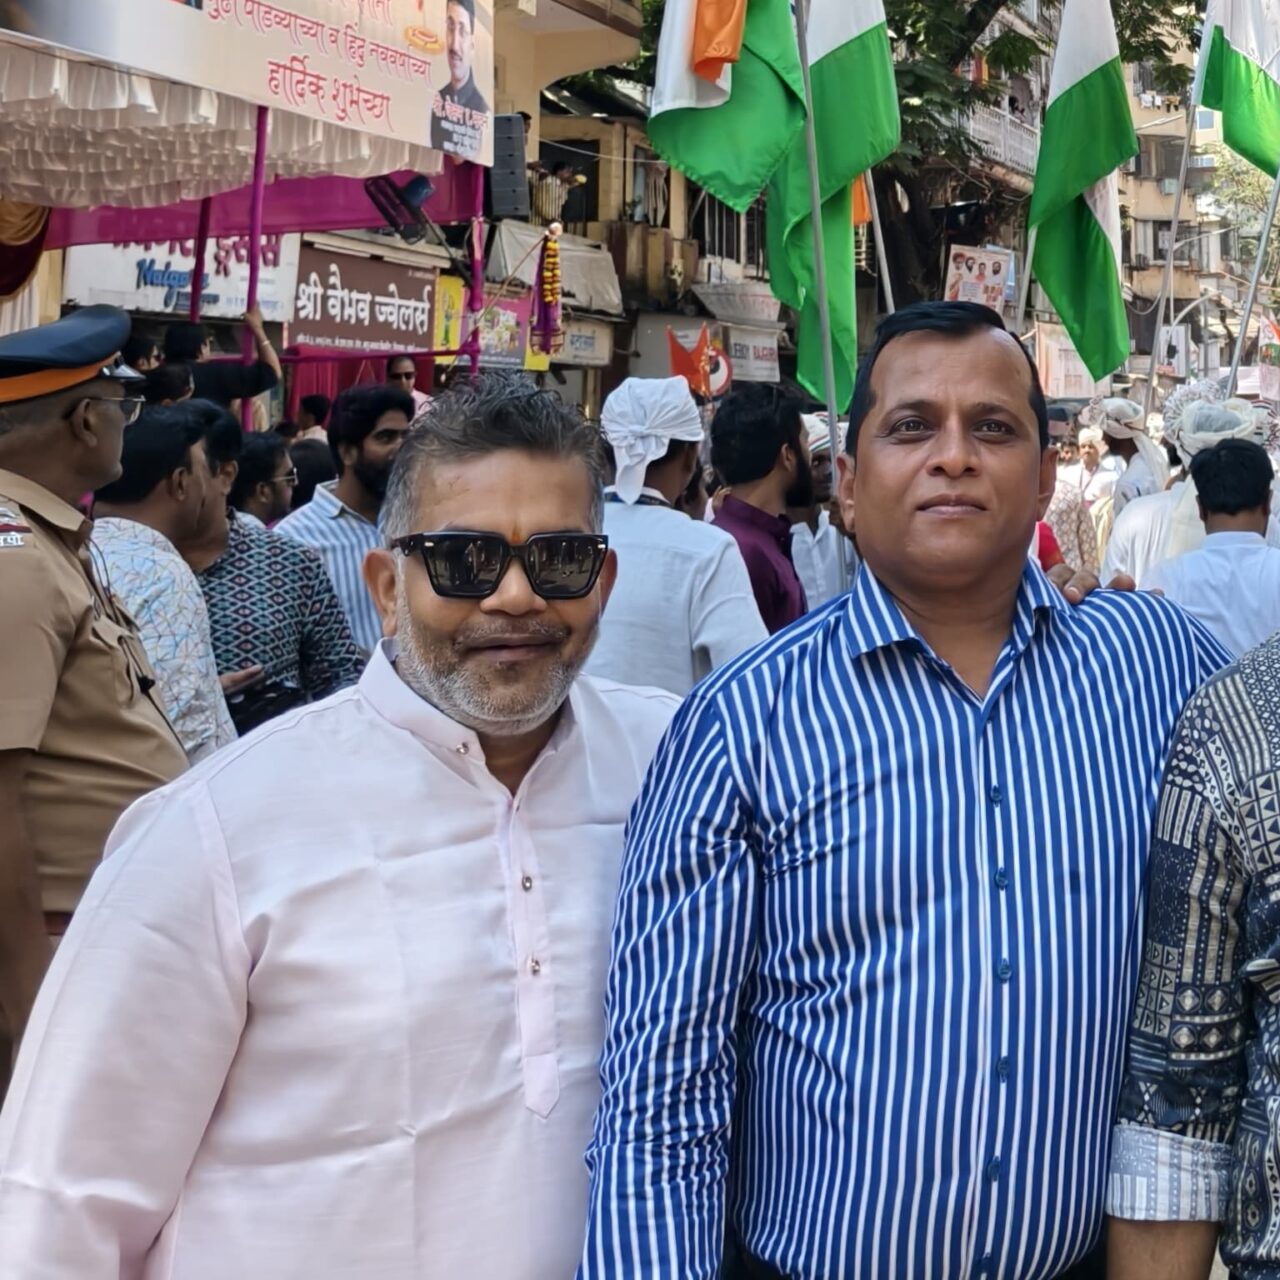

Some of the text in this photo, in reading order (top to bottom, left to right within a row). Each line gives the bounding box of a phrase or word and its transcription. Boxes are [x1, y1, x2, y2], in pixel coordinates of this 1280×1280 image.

[328, 26, 342, 56] व
[267, 55, 328, 115] हार्दिक
[332, 75, 396, 132] शुभेच्छा
[296, 272, 324, 321] श्री
[327, 263, 372, 327] वैभव
[374, 283, 432, 335] ज्वेलर्स
